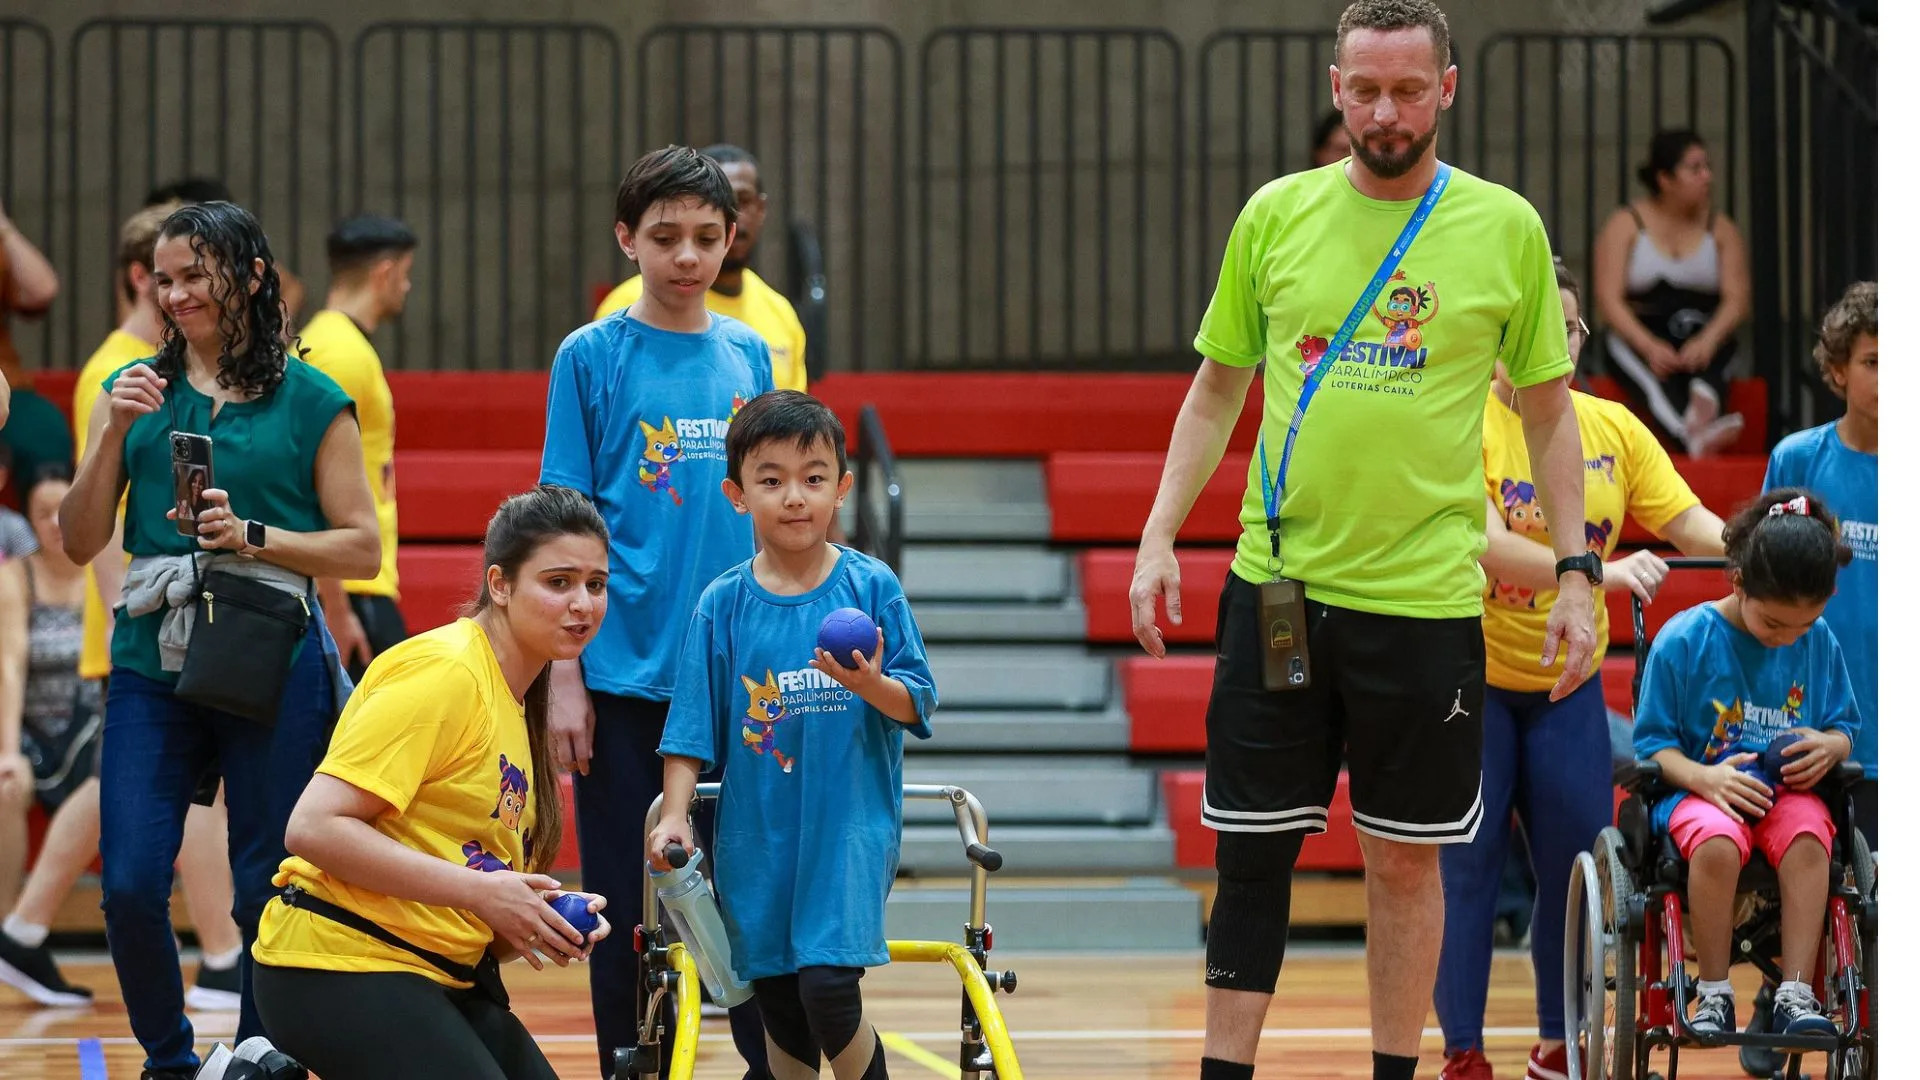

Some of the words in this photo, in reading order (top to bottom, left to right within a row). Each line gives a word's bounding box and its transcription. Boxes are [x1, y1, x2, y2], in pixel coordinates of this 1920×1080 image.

[1312, 348, 1341, 383] BRASIL
[1339, 340, 1428, 369] ESTIVAL
[1327, 363, 1423, 384] PARALÍMPICO
[1331, 380, 1380, 393] LOTERIAS
[1383, 385, 1415, 396] CAIXA
[778, 668, 844, 693] FESTIVA
[822, 704, 848, 712] CAIXA
